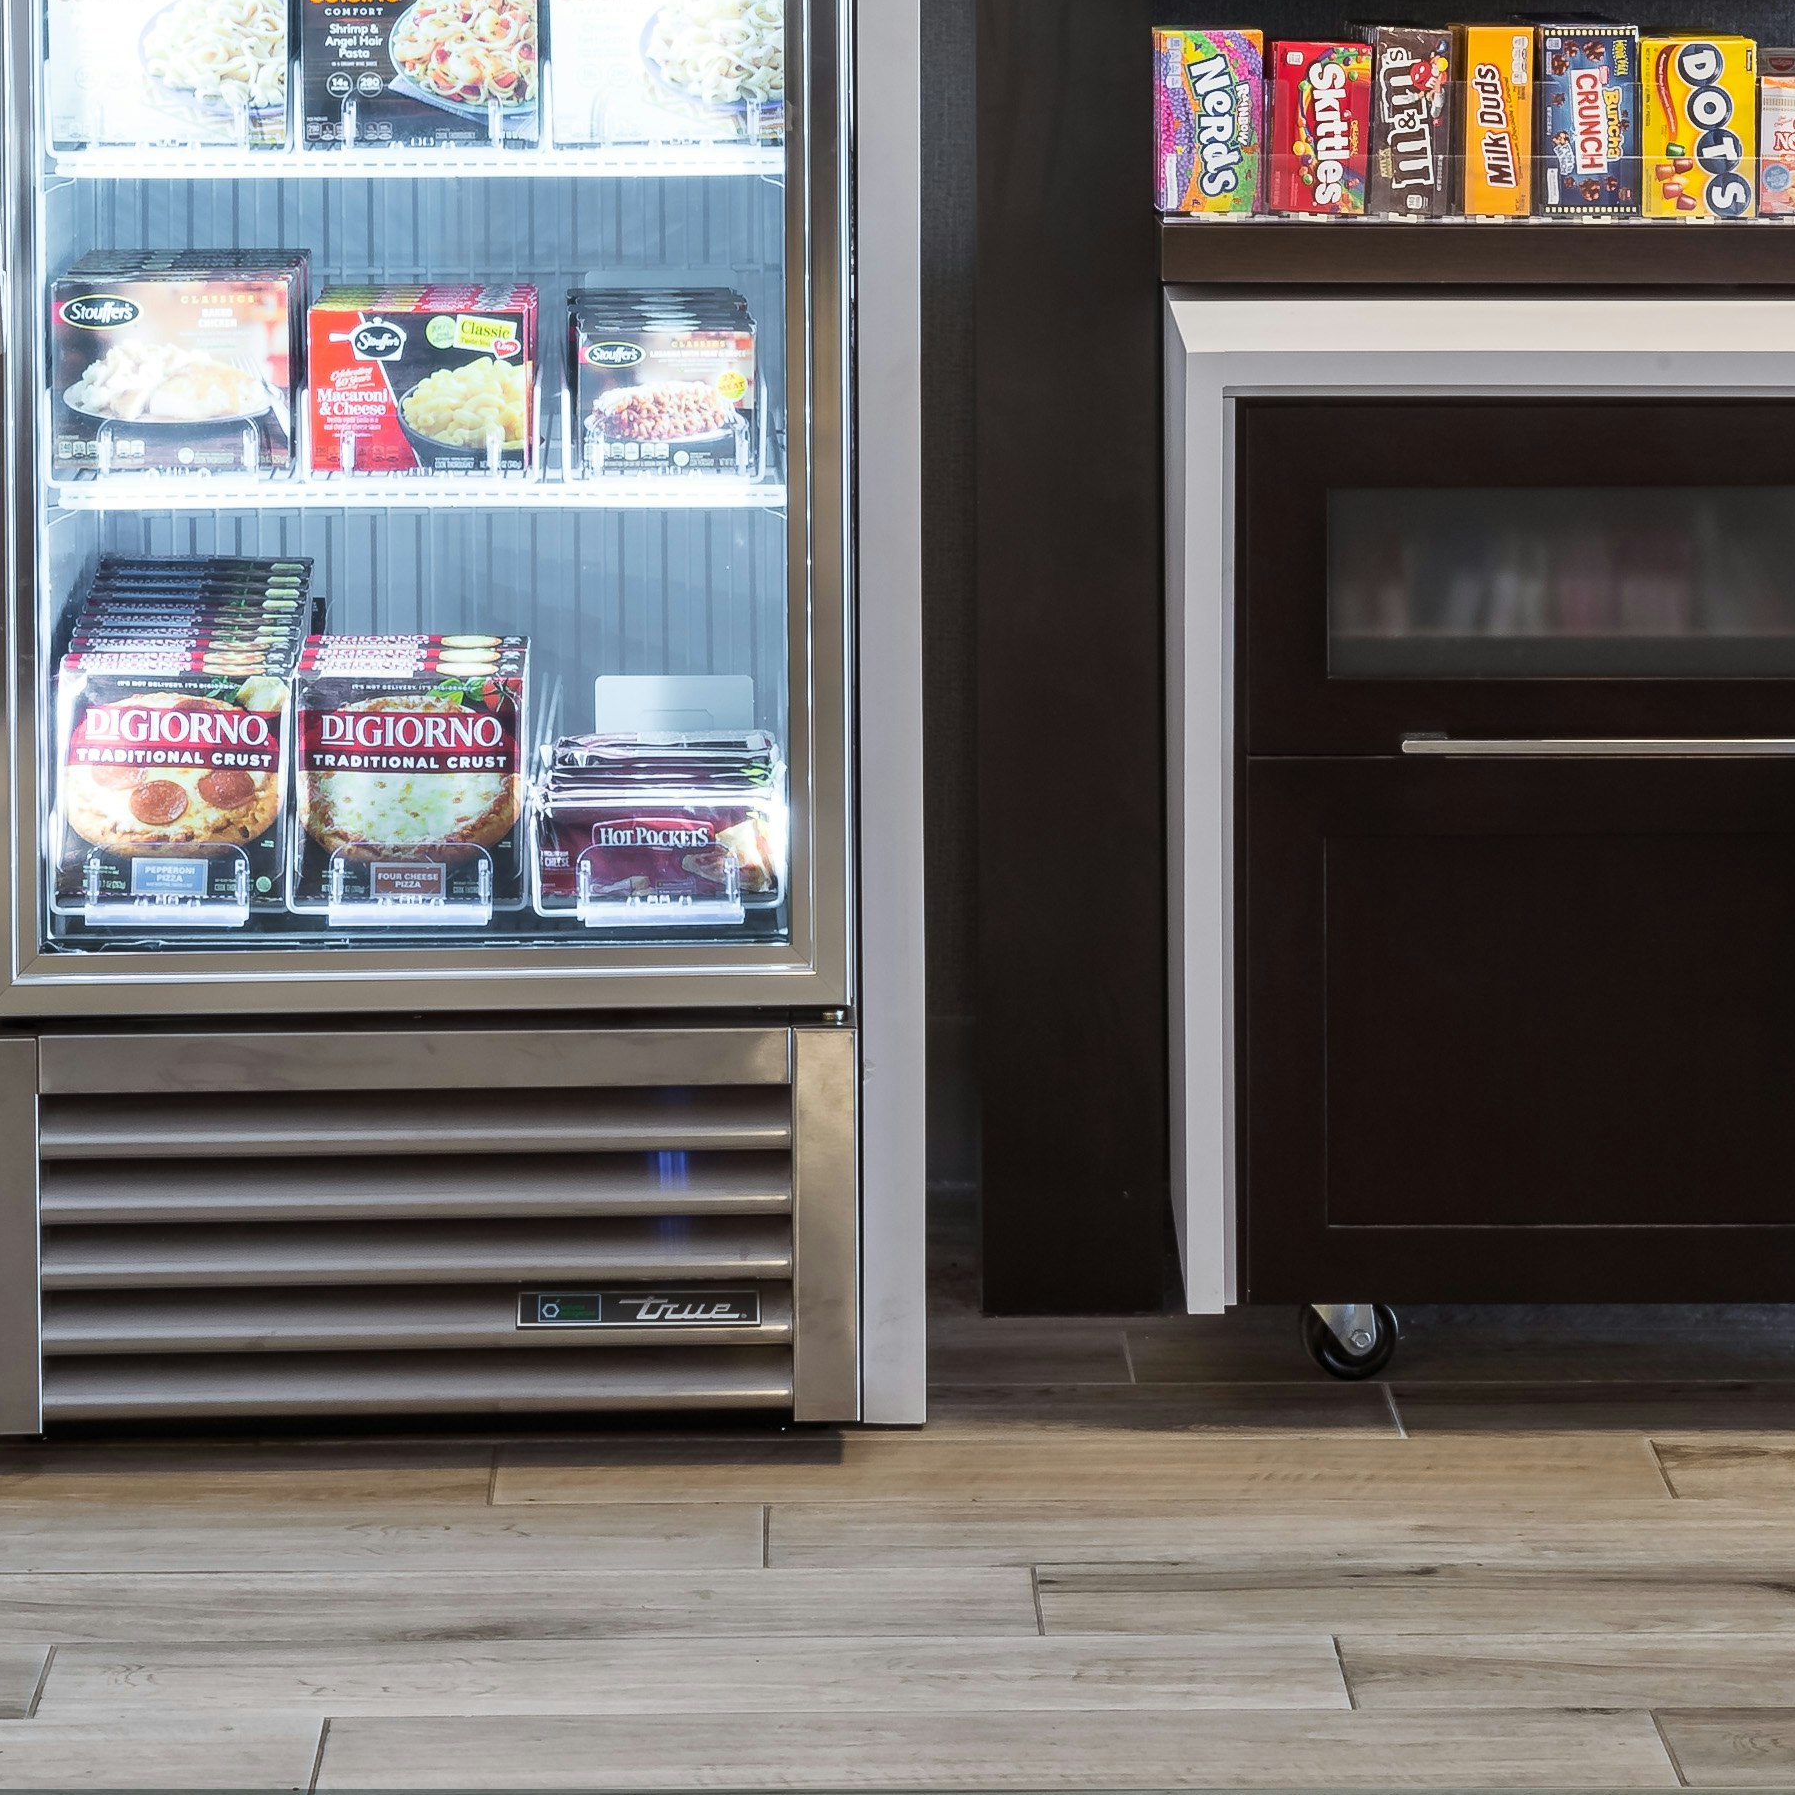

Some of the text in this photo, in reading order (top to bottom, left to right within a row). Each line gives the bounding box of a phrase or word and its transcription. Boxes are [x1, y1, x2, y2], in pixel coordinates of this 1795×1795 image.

[330, 23, 378, 36] Shrimp &
[325, 36, 383, 49] Angel Hair
[339, 49, 370, 58] Pasta
[1474, 67, 1513, 185] Milk Duds
[1576, 73, 1604, 169] CRUNCH
[1603, 89, 1621, 156] Buncha
[1309, 62, 1351, 205] Skittles
[1678, 44, 1751, 216] DOTS
[180, 295, 255, 304] CLASSICS
[70, 301, 134, 324] Stouffer's
[460, 320, 510, 339] Classic
[592, 348, 639, 363] Stouffer's
[317, 388, 387, 402] Macaroni
[319, 403, 386, 416] & Cheese
[76, 748, 272, 768] TRADITIONAL CRUST
[313, 755, 507, 769] TRADITIONAL CRUST
[600, 827, 709, 848] HOT POCKETS
[145, 866, 196, 875] PEPPERONI
[156, 874, 184, 882] PIZZA
[395, 880, 422, 888] PIZZA
